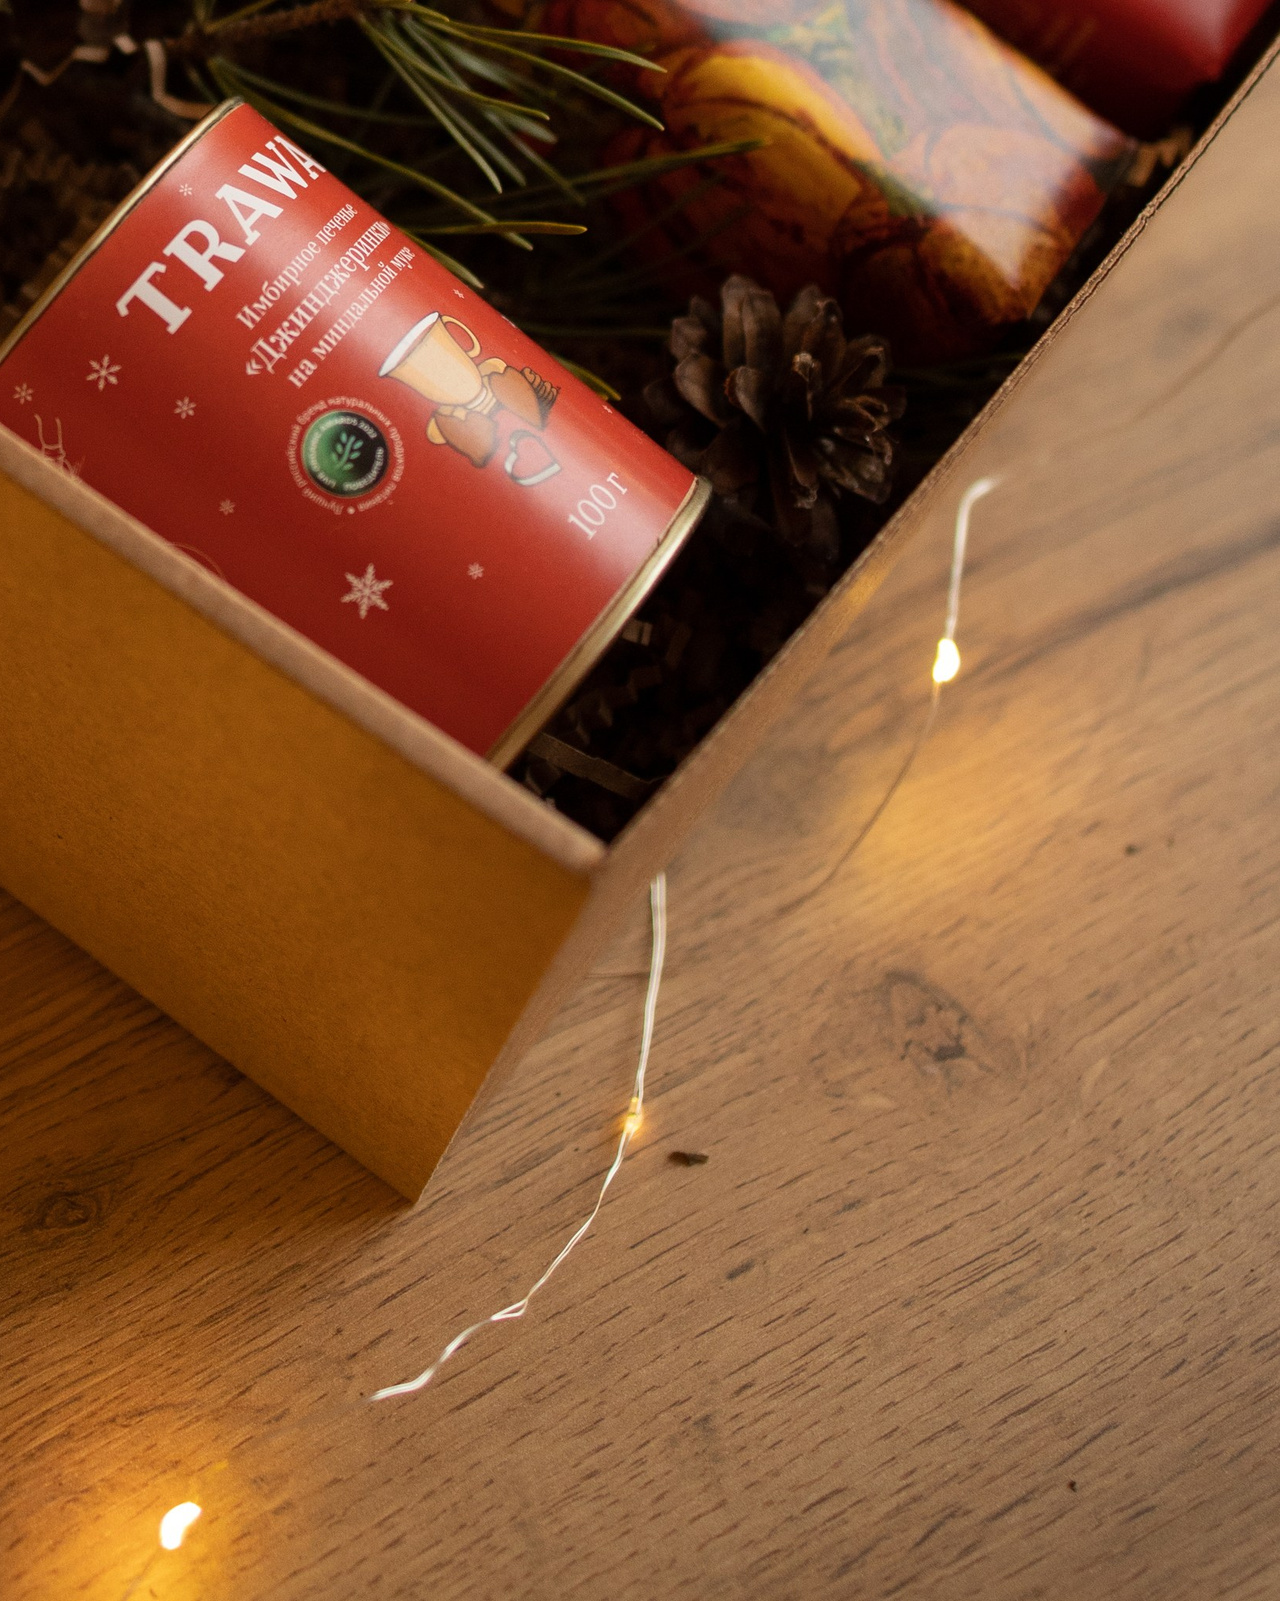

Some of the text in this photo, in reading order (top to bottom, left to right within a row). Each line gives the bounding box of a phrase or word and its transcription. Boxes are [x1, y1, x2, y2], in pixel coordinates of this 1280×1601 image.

[115, 135, 326, 335] TRAWA
[235, 203, 357, 330] Имбирное печенье
[287, 246, 416, 389] на миндальной муке
